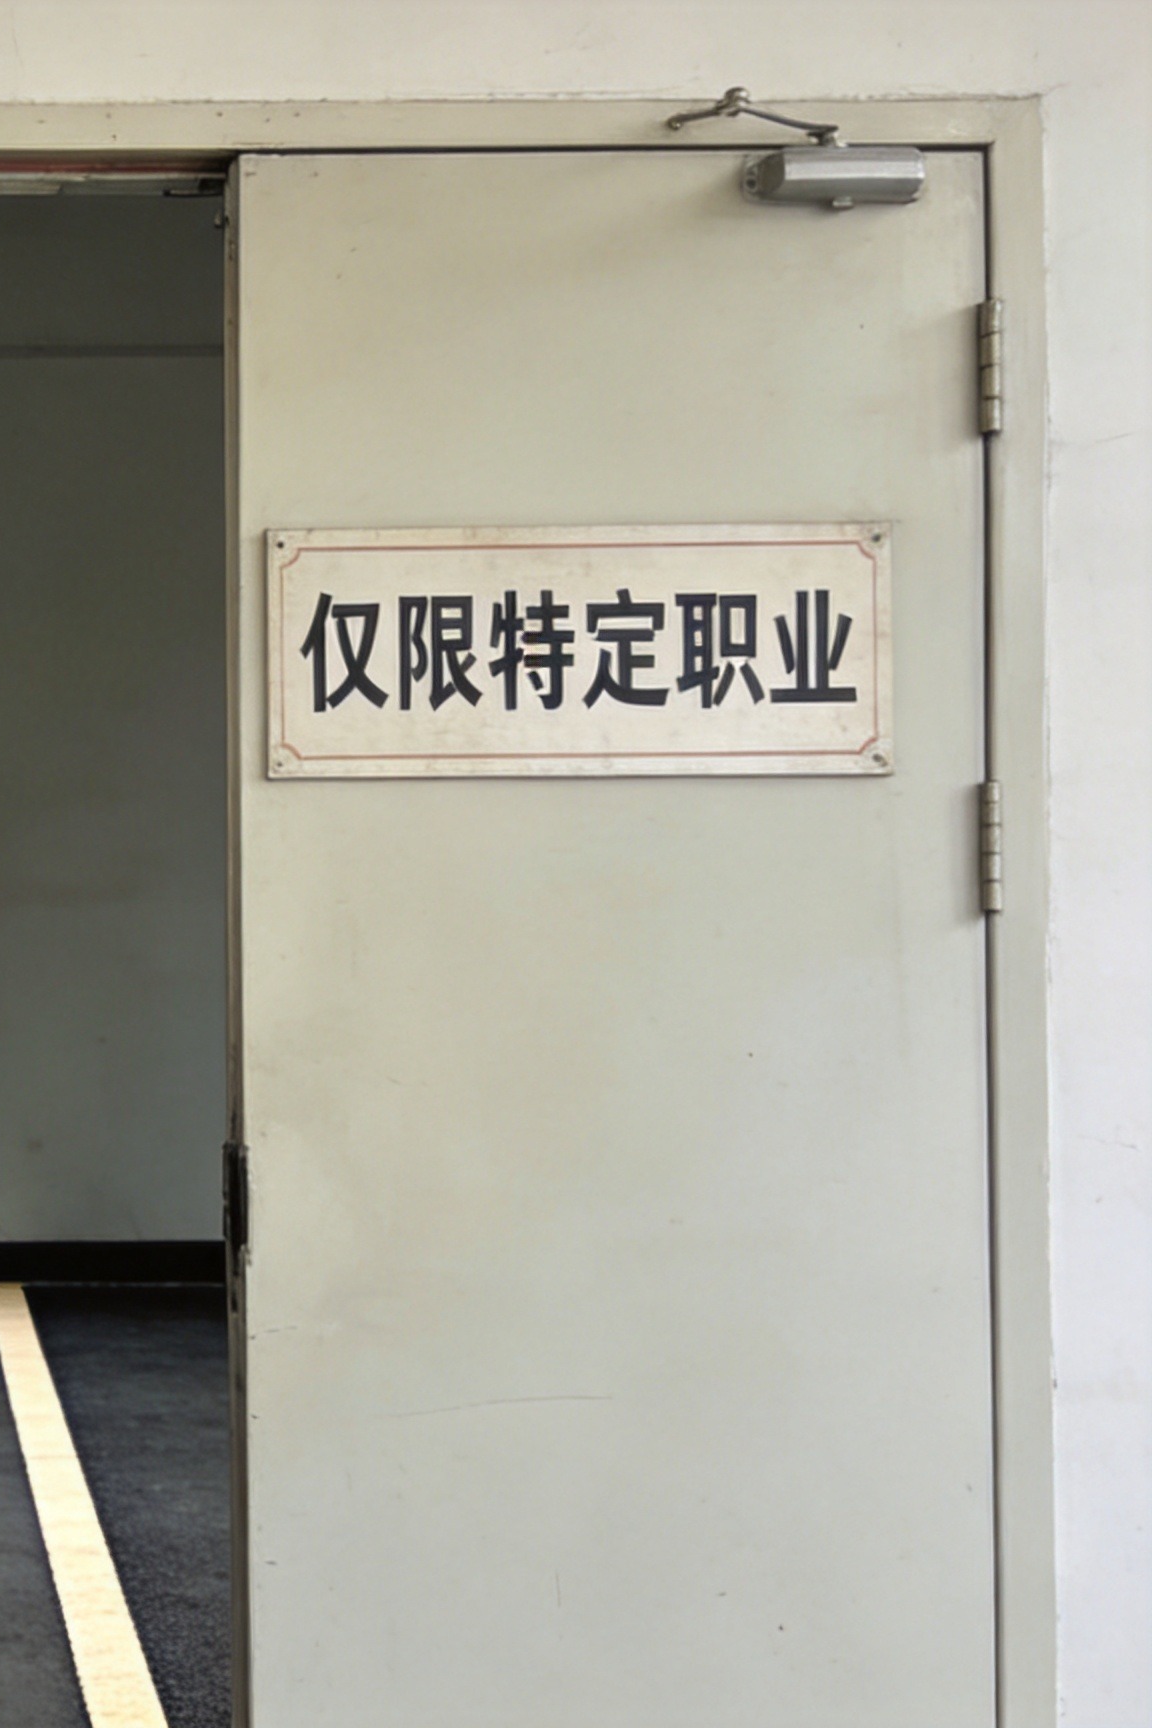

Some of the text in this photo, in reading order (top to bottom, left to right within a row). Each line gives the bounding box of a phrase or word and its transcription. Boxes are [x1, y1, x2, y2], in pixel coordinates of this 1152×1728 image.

[300, 588, 857, 713] 仅限特定职业
